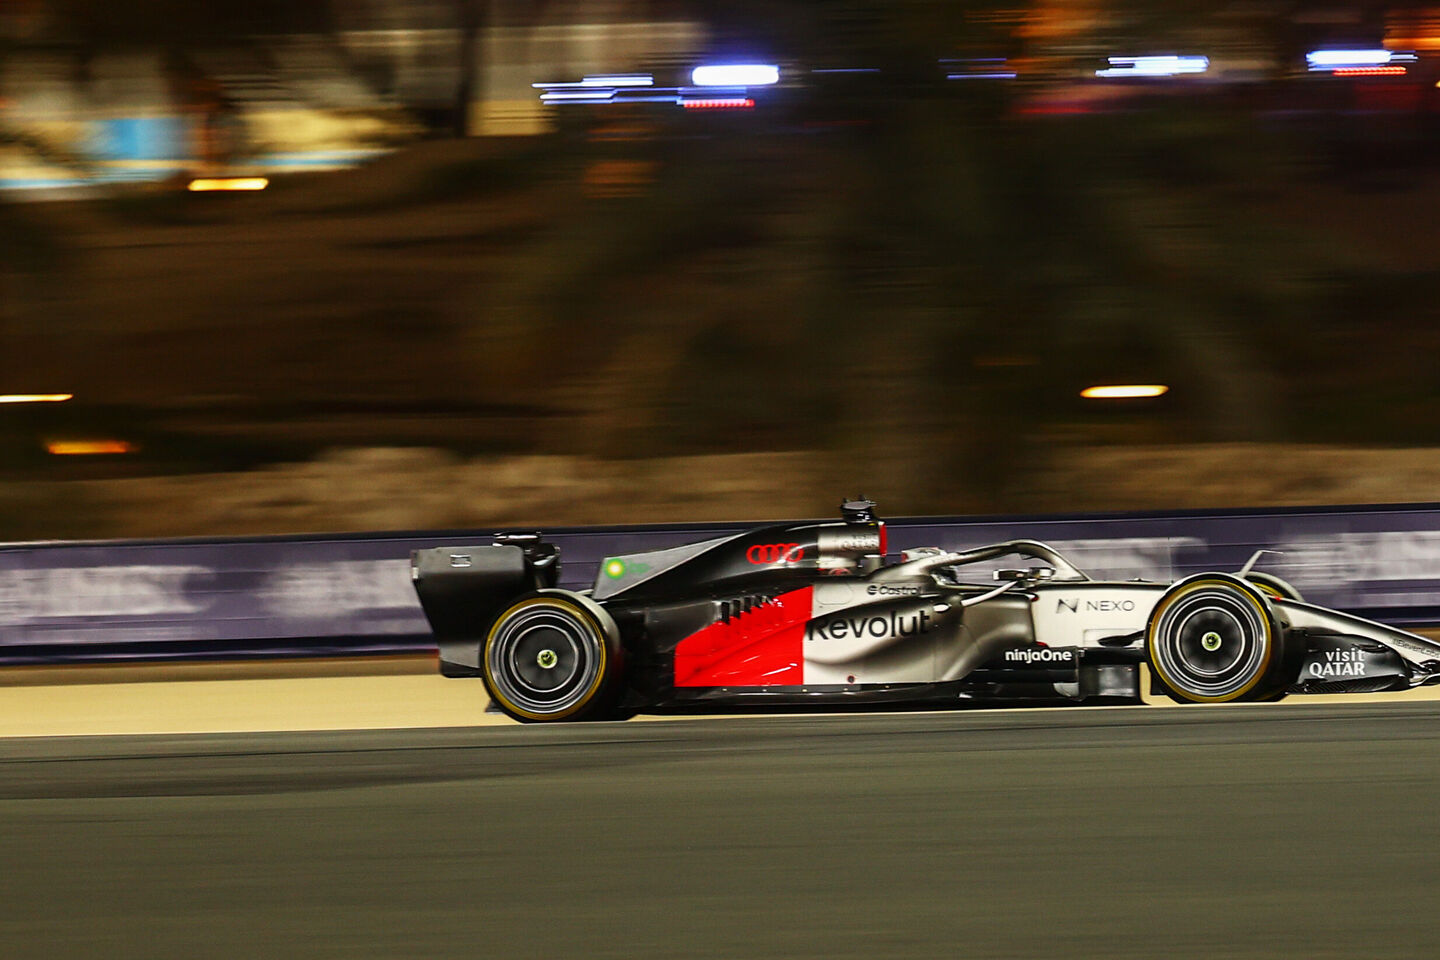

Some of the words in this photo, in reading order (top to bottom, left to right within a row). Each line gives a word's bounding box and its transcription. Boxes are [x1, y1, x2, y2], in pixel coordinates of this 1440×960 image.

[1086, 600, 1135, 611] NEXO
[807, 610, 930, 640] Revolut
[1004, 649, 1072, 663] ninjaOne
[1325, 648, 1365, 662] visit
[1309, 662, 1365, 678] QATAR
